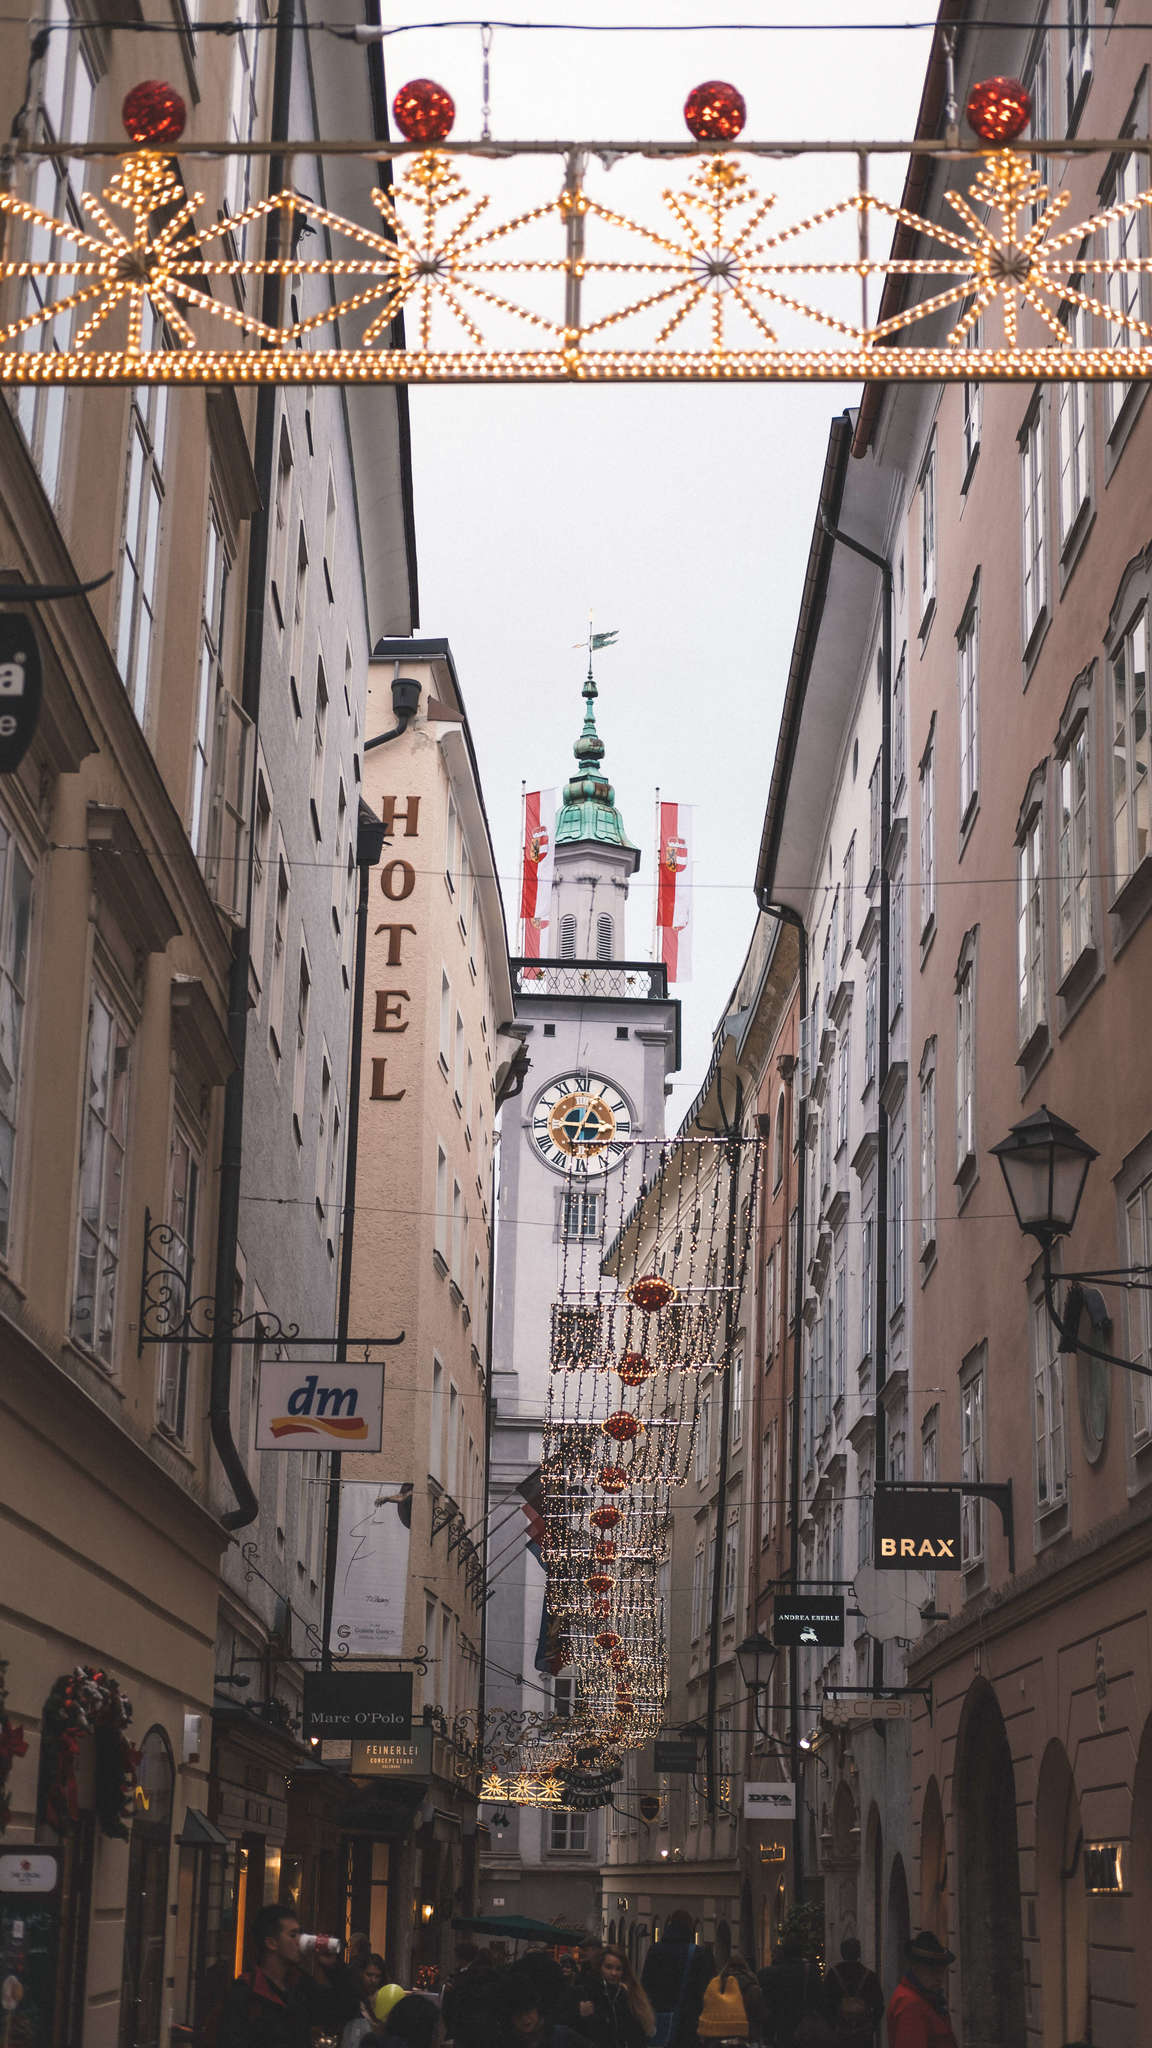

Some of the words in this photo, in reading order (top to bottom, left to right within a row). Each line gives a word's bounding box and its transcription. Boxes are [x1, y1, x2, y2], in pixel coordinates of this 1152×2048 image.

[370, 796, 420, 1100] HOTEL
[554, 1082, 571, 1097] XI
[575, 1079, 592, 1092] XII
[540, 1097, 555, 1109] X
[611, 1101, 625, 1112] II
[616, 1122, 630, 1132] III
[287, 1375, 359, 1417] dm
[881, 1537, 955, 1558] BRAX
[311, 1711, 351, 1725] Marc
[354, 1711, 405, 1726] O'Polo
[366, 1745, 419, 1756] FEINERLEI
[748, 1793, 793, 1802] DIVA
